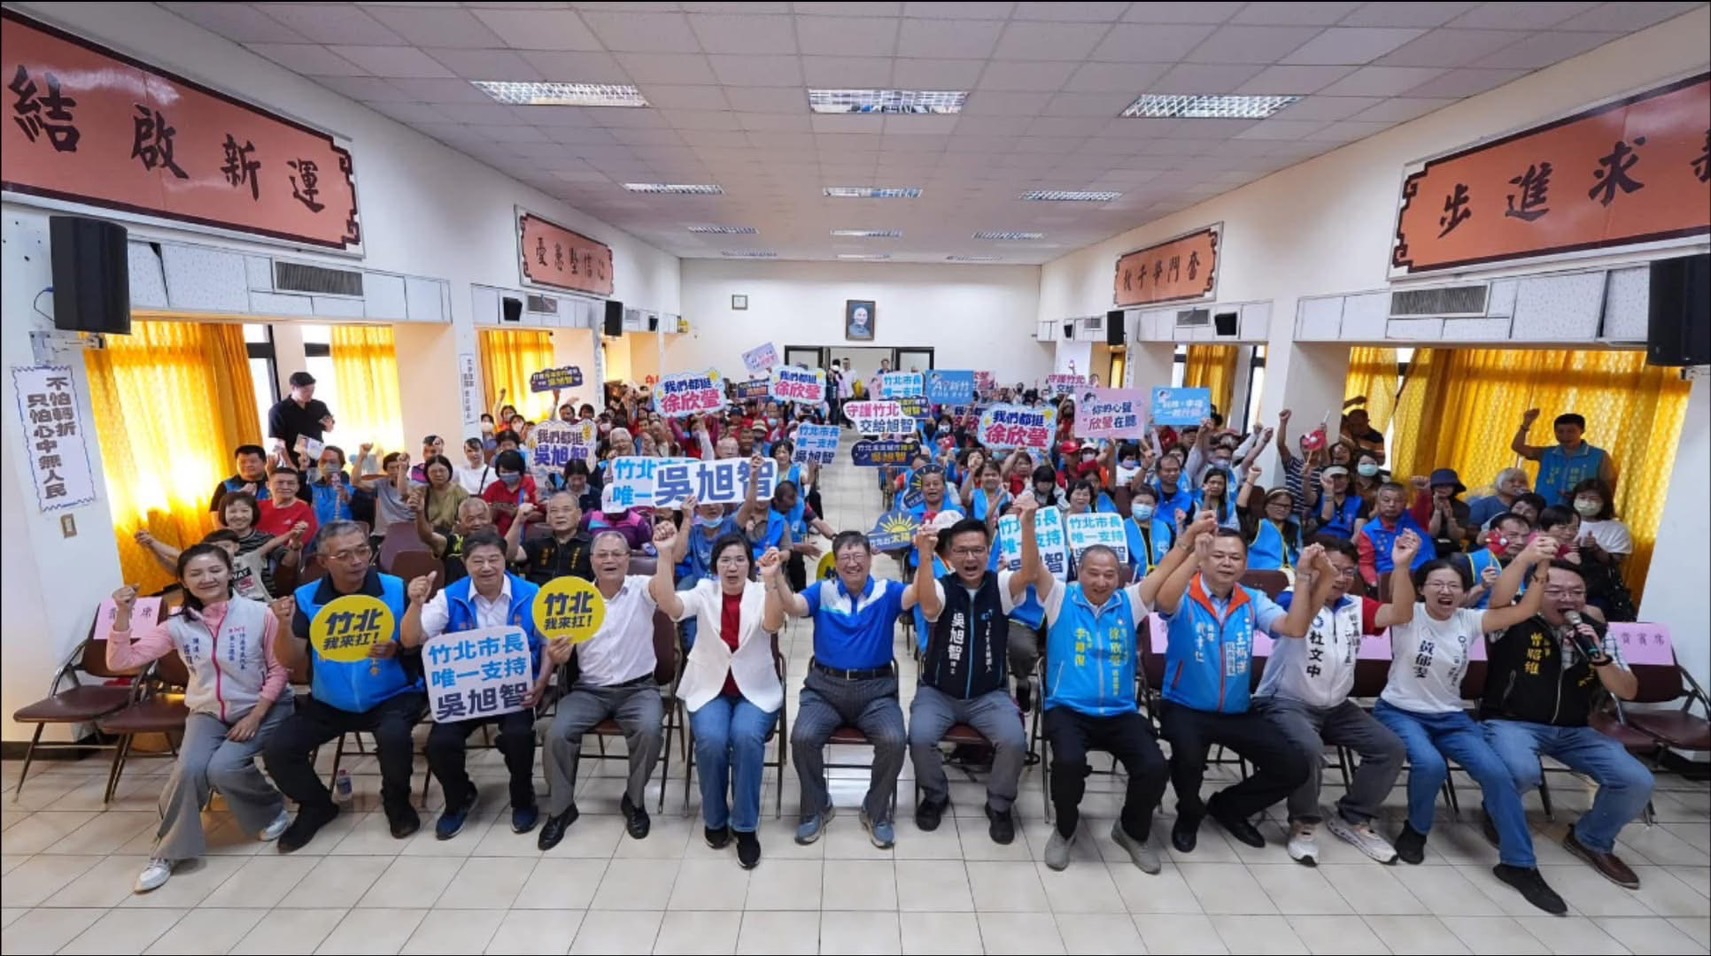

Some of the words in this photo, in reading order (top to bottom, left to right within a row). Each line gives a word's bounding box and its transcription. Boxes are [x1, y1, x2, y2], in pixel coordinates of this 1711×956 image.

[664, 377, 713, 395] 我們都挺
[46, 377, 76, 437] 不怕轉折
[846, 403, 900, 418] 守護竹北
[993, 410, 1044, 426] 我們都挺
[799, 425, 839, 436] 竹北市長
[860, 419, 914, 433] 交給旭智
[985, 426, 1049, 448] 徐欣瑩
[27, 393, 67, 500] 只怕心中無人民
[793, 450, 834, 464] 吳旭智
[655, 460, 776, 507] 吳旭智
[1070, 516, 1121, 529] 竹北市長
[1071, 530, 1124, 543] 唯一支持
[544, 591, 594, 616] 竹北
[325, 608, 383, 636] 竹北
[948, 612, 965, 661] 吳旭智
[428, 633, 524, 666] 竹北市長
[1306, 630, 1325, 678] 杜文中
[431, 658, 528, 690] 唯一支持
[436, 682, 529, 721] 吳旭智
